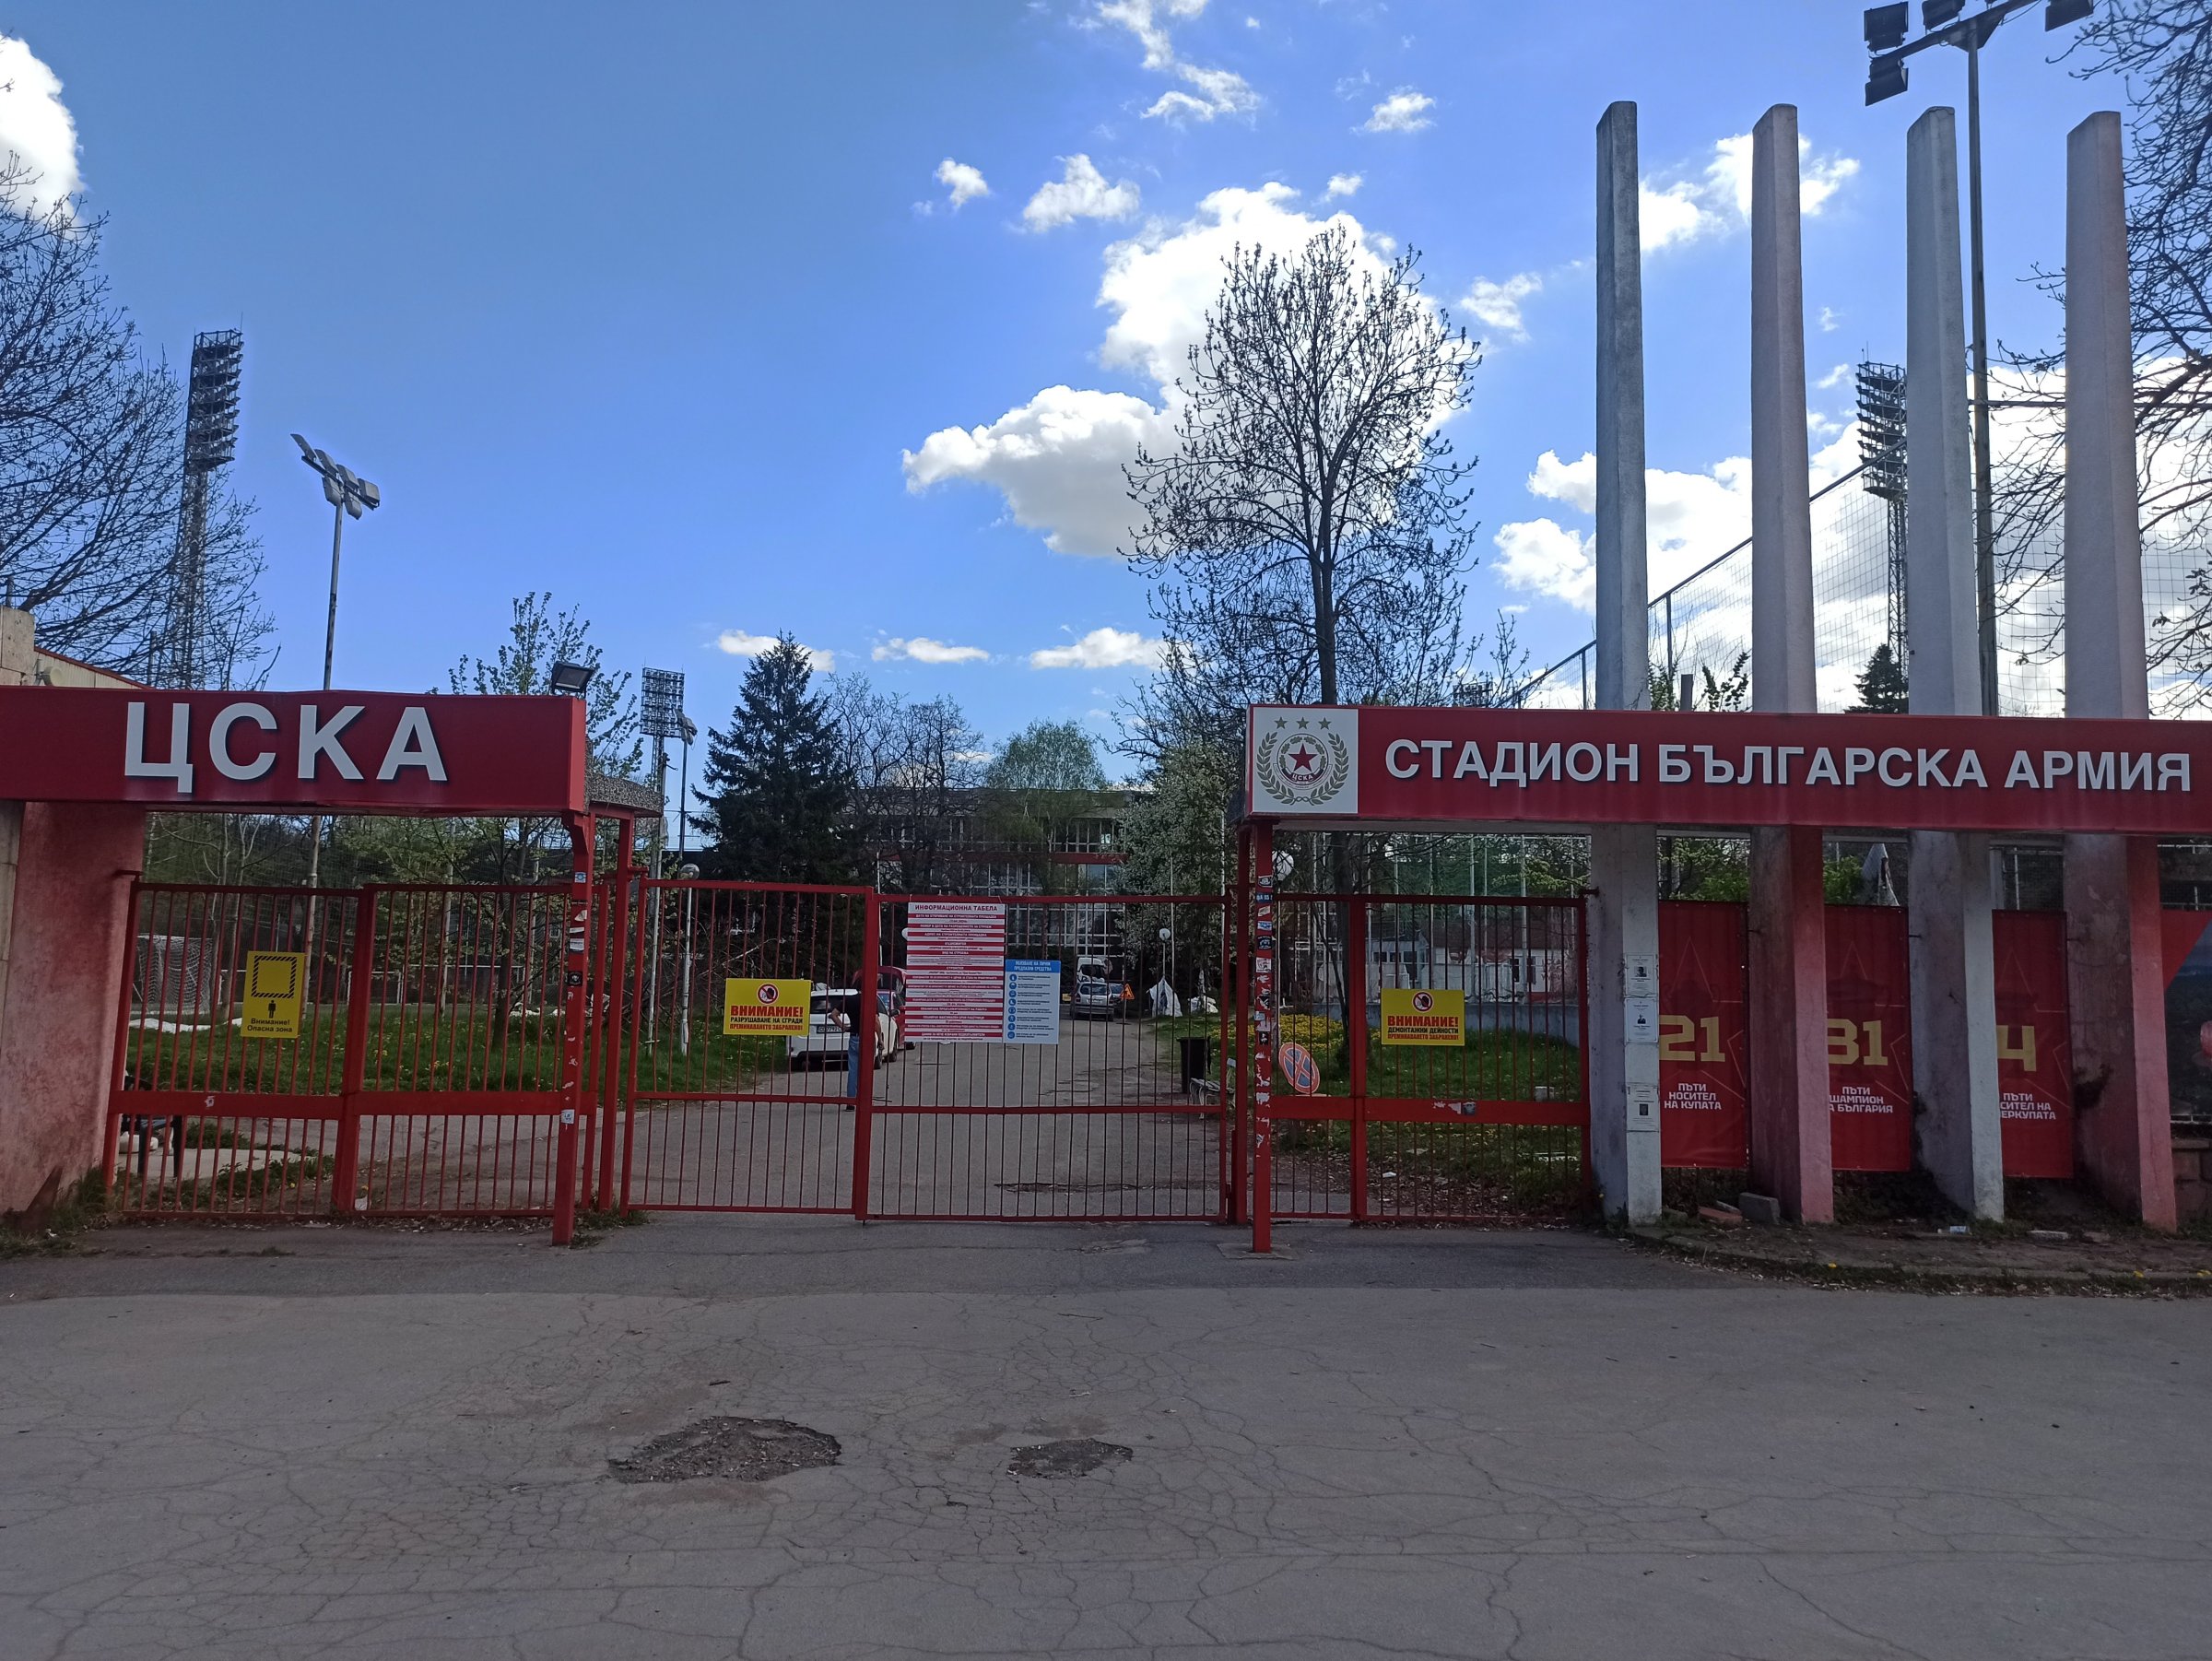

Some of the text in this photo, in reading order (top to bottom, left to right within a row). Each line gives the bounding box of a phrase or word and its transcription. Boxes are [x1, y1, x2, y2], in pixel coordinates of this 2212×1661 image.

[124, 701, 447, 794] ЦСКА
[1385, 739, 2192, 792] СТАДИОН БЪЛГАРСКА АРМИЯ
[731, 1006, 804, 1017] ВНИМАНИЕ!
[1388, 1016, 1459, 1027] ВНИМАНИЕ!
[1659, 1015, 1725, 1062] 21
[1827, 1019, 1888, 1066] 31
[1678, 1083, 1706, 1091] ПЪТИ
[1842, 1087, 1870, 1095] ПЪТИ
[1669, 1092, 1716, 1101] НОСИТЕЛ
[1830, 1095, 1884, 1103] ШАМПИОН
[2003, 1093, 2033, 1101] ПЪТИ
[1681, 1101, 1722, 1110] КУПАТА
[1837, 1104, 1893, 1113] БЪЛГАРИЯ
[2000, 1101, 2052, 1111] СИТЕЛ НА
[2001, 1111, 2056, 1120] ЕРКУПАТА
